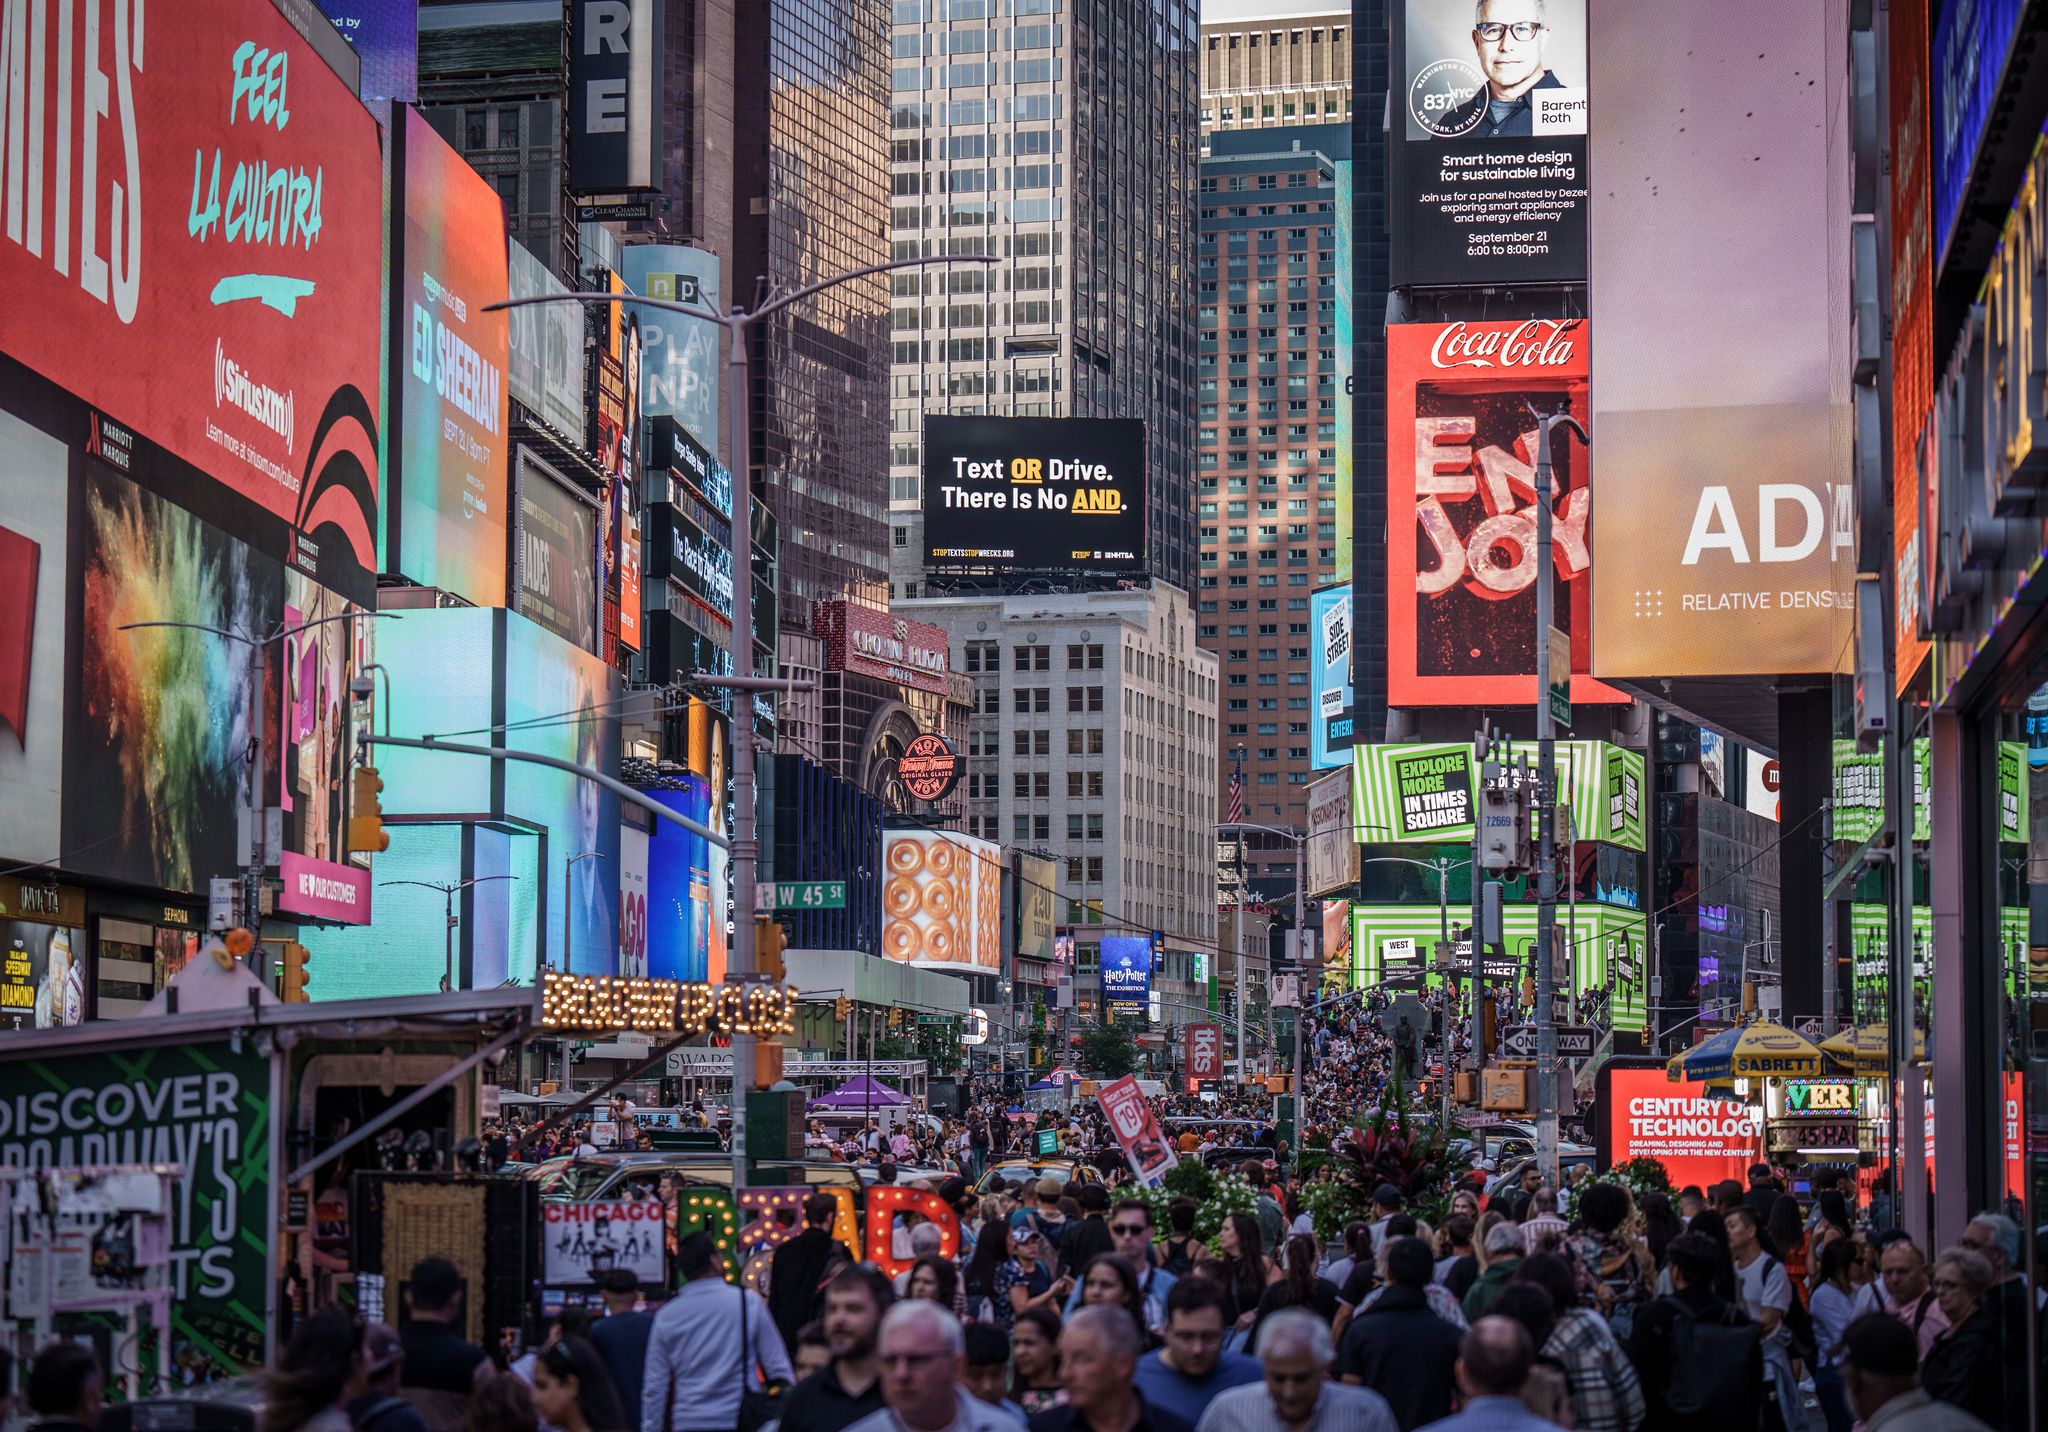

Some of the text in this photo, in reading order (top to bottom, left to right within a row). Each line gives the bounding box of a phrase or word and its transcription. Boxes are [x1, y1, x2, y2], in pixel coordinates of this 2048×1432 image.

[346, 17, 361, 29] by
[231, 41, 289, 131] FEEL
[1416, 63, 1458, 89] WASHINGTON
[1423, 93, 1453, 110] 837
[1541, 99, 1587, 112] Barent
[1417, 110, 1431, 125] NEW
[1454, 123, 1464, 132] NY
[1541, 113, 1571, 124] Roth
[1442, 150, 1572, 167] Smart home design
[1440, 166, 1575, 182] for sustainable living
[188, 148, 323, 251] LA CULTURA
[1419, 193, 1439, 203] Join
[1440, 193, 1452, 202] us
[1453, 191, 1468, 201] for
[1478, 190, 1507, 203] panel
[1508, 189, 1543, 200] hosted
[1544, 188, 1556, 202] by
[1440, 198, 1576, 215] exploring smart appliances
[1454, 211, 1562, 224] and energy efficiency
[1468, 231, 1547, 246] September 21
[1467, 244, 1549, 257] 6:00 to 8:00pm
[412, 301, 499, 440] ED SHEERAN
[649, 368, 711, 414] NPR
[103, 421, 134, 449] MARRIOTT
[206, 416, 224, 446] Learn
[223, 432, 240, 457] more
[103, 442, 130, 469] MARQUIS
[952, 457, 1114, 484] Text OR Drive.
[941, 486, 1128, 515] There Is No AND.
[298, 535, 319, 558] MARRIOTT
[932, 548, 1014, 558] STOPTEXTSSTOPWRECKS.ORG
[1111, 551, 1135, 559] NHTSA
[298, 552, 317, 573] MARQUIS
[1682, 592, 1772, 611] RELATIVE
[1329, 616, 1344, 643] SIDE
[908, 645, 945, 672] PLAZA
[1327, 632, 1350, 665] STREET
[1321, 690, 1342, 706] DISCOVER
[914, 740, 940, 755] HOT
[1400, 755, 1465, 778] EXPLORE
[914, 778, 940, 795] NOW
[1402, 776, 1445, 796] MORE
[1404, 789, 1467, 813] IN TIMES
[1406, 806, 1466, 830] SQUARE
[1485, 815, 1512, 827] 72669
[299, 873, 309, 895] WE
[315, 881, 327, 899] OUR
[327, 881, 356, 905] CUSTOMERS
[779, 883, 842, 905] W 45 St
[163, 907, 189, 924] SEPHORA
[1389, 940, 1409, 950] WEST
[5, 960, 32, 977] SPEEDWAY
[1104, 968, 1147, 984] Harry Potter
[1, 984, 35, 1008] DIAMOND
[1558, 1035, 1586, 1048] WAY
[1745, 1035, 1795, 1045] SABRETT
[1193, 1028, 1216, 1073] tkts
[1737, 1057, 1817, 1073] SABRETT
[1119, 1104, 1138, 1129] 19
[1629, 1097, 1723, 1117] CENTURY
[1629, 1118, 1764, 1138] TECHNOLOGY
[1629, 1140, 1669, 1149] DREAMING,
[1668, 1140, 1707, 1148] DESIGNING
[1721, 1149, 1755, 1157] CENTURY
[544, 1203, 664, 1223] CHICAGO
